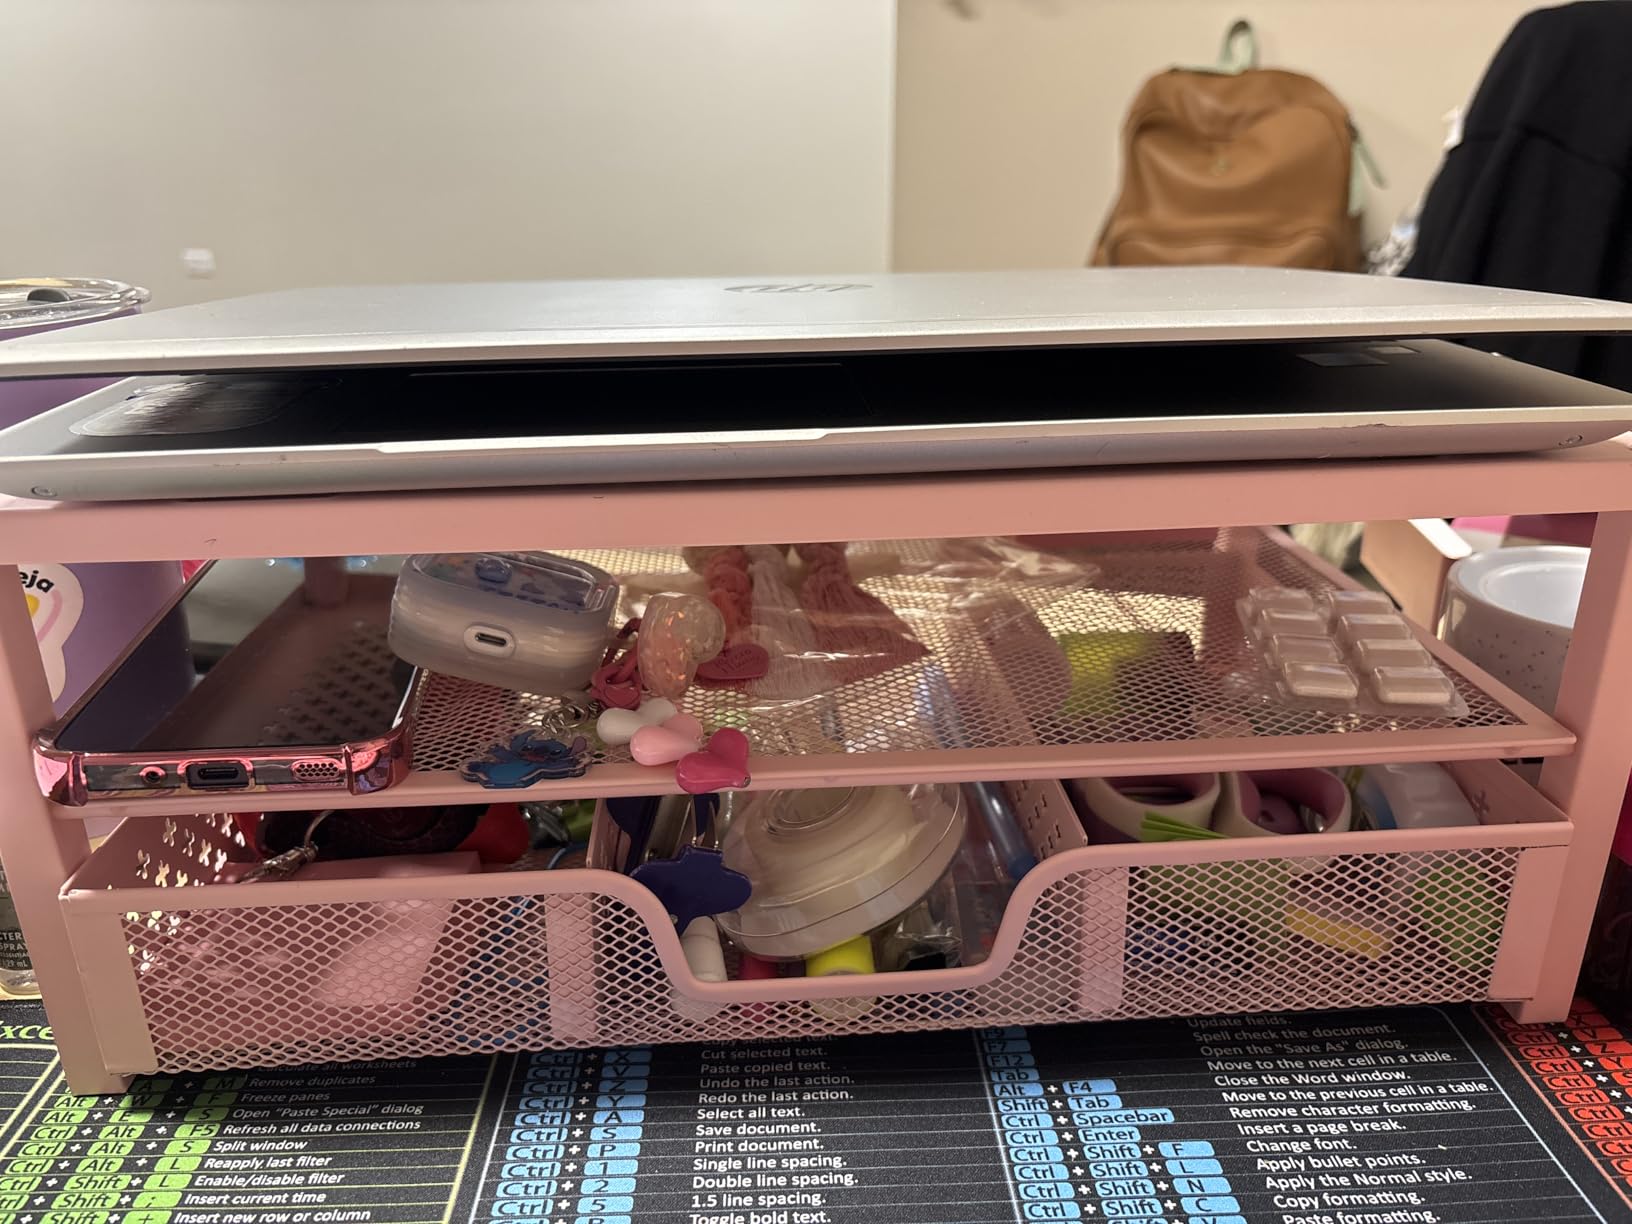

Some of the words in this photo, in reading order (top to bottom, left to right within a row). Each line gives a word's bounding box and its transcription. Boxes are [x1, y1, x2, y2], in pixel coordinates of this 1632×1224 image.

[19, 569, 54, 593] eja
[1186, 1016, 1242, 1029] Update
[1245, 1015, 1293, 1026] fields.
[0, 1021, 54, 1041] xce
[1192, 1030, 1231, 1044] Spell
[1234, 1029, 1279, 1041] check
[1281, 1028, 1309, 1039] the
[1312, 1023, 1396, 1037] document.
[701, 1050, 726, 1060] Cut
[730, 1047, 790, 1059] selected
[795, 1047, 828, 1056] text.
[1200, 1045, 1243, 1057] Open
[1245, 1044, 1273, 1055] the
[1275, 1043, 1321, 1054] "Save
[1325, 1040, 1350, 1052] As"
[1354, 1038, 1408, 1050] dialog.
[343, 1060, 416, 1070] worksheets
[701, 1063, 740, 1074] Paste
[744, 1061, 793, 1075] copied
[798, 1060, 831, 1070] text.
[991, 1055, 1025, 1066] F12
[1206, 1060, 1253, 1071] Move
[1255, 1059, 1274, 1069] to
[1276, 1058, 1305, 1069] the
[1308, 1057, 1345, 1068] next
[1347, 1054, 1376, 1066] cell
[1377, 1053, 1396, 1065] in
[1399, 1055, 1408, 1064] a
[1410, 1050, 1457, 1063] table.
[250, 1077, 304, 1087] Remove
[307, 1075, 376, 1087] duplicates
[700, 1077, 740, 1088] Undo
[744, 1076, 770, 1087] the
[774, 1075, 800, 1086] last
[803, 1074, 855, 1086] action.
[996, 1069, 1029, 1080] Tab
[1214, 1075, 1259, 1086] Close
[1260, 1074, 1290, 1085] the
[1291, 1072, 1340, 1084] Word
[1341, 1070, 1411, 1083] window.
[698, 1092, 737, 1104] Redo
[741, 1091, 767, 1102] the
[771, 1091, 798, 1101] last
[802, 1089, 854, 1101] action.
[1000, 1084, 1025, 1096] Alt
[1221, 1091, 1267, 1102] Move
[1268, 1090, 1287, 1101] to
[1289, 1089, 1317, 1100] the
[1319, 1087, 1387, 1101] previous
[1389, 1084, 1417, 1097] cell
[1417, 1084, 1435, 1095] in
[1436, 1085, 1448, 1094] a
[1448, 1081, 1493, 1093] table.
[56, 1097, 85, 1107] Alt
[241, 1093, 287, 1102] Freeze
[289, 1093, 330, 1103] panes
[1072, 1096, 1109, 1109] Tab
[45, 1111, 75, 1122] Alt
[232, 1108, 270, 1119] Open
[381, 1104, 423, 1116] dialog
[697, 1108, 744, 1120] Select
[748, 1106, 766, 1118] all
[771, 1106, 805, 1117] text.
[1229, 1106, 1298, 1119] Remove
[1301, 1104, 1379, 1117] character
[1382, 1099, 1476, 1113] formatting.
[521, 1112, 566, 1125] Ctrl
[1005, 1115, 1041, 1128] Ctrl
[1076, 1108, 1168, 1126] Spacebar
[34, 1127, 72, 1138] Ctrl
[104, 1127, 136, 1138] Alt
[190, 1125, 215, 1136] F5
[223, 1124, 277, 1135] Refresh
[280, 1123, 298, 1133] all
[300, 1123, 332, 1133] data
[335, 1120, 421, 1132] connections
[695, 1125, 732, 1136] Save
[736, 1122, 822, 1135] document.
[1237, 1123, 1290, 1135] Insert
[1292, 1123, 1304, 1133] a
[1306, 1122, 1348, 1136] page
[1350, 1118, 1407, 1132] break.
[516, 1128, 563, 1142] Ctrl
[1009, 1131, 1044, 1144] Ctrl
[1082, 1129, 1135, 1142] Enter
[22, 1143, 62, 1155] Ctrl
[95, 1142, 126, 1154] Alt
[213, 1140, 247, 1152] Split
[249, 1139, 308, 1150] window
[512, 1145, 559, 1159] Ctrl
[695, 1141, 734, 1153] Print
[737, 1138, 824, 1152] document.
[1014, 1147, 1049, 1161] Ctrl
[1087, 1144, 1136, 1159] Shift
[1246, 1139, 1312, 1153] Change
[1314, 1137, 1357, 1150] font.
[10, 1159, 49, 1172] Ctrl
[82, 1159, 115, 1171] Alt
[266, 1157, 297, 1168] last
[299, 1155, 332, 1167] filter
[692, 1158, 742, 1173] Single
[747, 1157, 777, 1169] line
[781, 1155, 847, 1170] spacing.
[1257, 1156, 1306, 1172] Apply
[1307, 1154, 1362, 1168] bullet
[1364, 1153, 1426, 1169] points.
[508, 1163, 555, 1177] Ctrl
[1018, 1165, 1055, 1179] Ctrl
[1093, 1162, 1143, 1177] Shift
[71, 1176, 123, 1189] Shift
[194, 1174, 304, 1188] Enable/disable
[307, 1172, 345, 1185] filter
[692, 1175, 752, 1189] Double
[756, 1174, 787, 1187] line
[791, 1172, 859, 1188] spacing.
[1266, 1174, 1315, 1191] Apply
[1319, 1173, 1351, 1187] the
[1352, 1170, 1422, 1185] Normal
[1424, 1167, 1473, 1183] style.
[502, 1181, 551, 1196] Ctrl
[1023, 1184, 1060, 1198] Ctrl
[1098, 1180, 1150, 1196] Shift
[58, 1194, 111, 1207] Shift
[184, 1194, 235, 1205] Insert
[236, 1194, 291, 1204] current
[292, 1192, 327, 1203] time
[691, 1194, 718, 1208] 1.5
[722, 1193, 753, 1207] line
[757, 1192, 827, 1208] spacing.
[1273, 1194, 1319, 1210] Copy
[1322, 1191, 1426, 1206] formatting.
[498, 1199, 547, 1215] Ctrl
[1028, 1203, 1067, 1217] Ctrl
[1105, 1199, 1157, 1216] Shift
[174, 1212, 225, 1223] Insert
[226, 1214, 257, 1223] new
[259, 1213, 290, 1223] row
[293, 1213, 311, 1222] or
[314, 1210, 371, 1222] column
[689, 1213, 745, 1224] Toggle
[750, 1211, 788, 1224] bold
[792, 1211, 831, 1223] text.
[1282, 1213, 1334, 1224] Paste
[1336, 1209, 1441, 1224] formatting.
